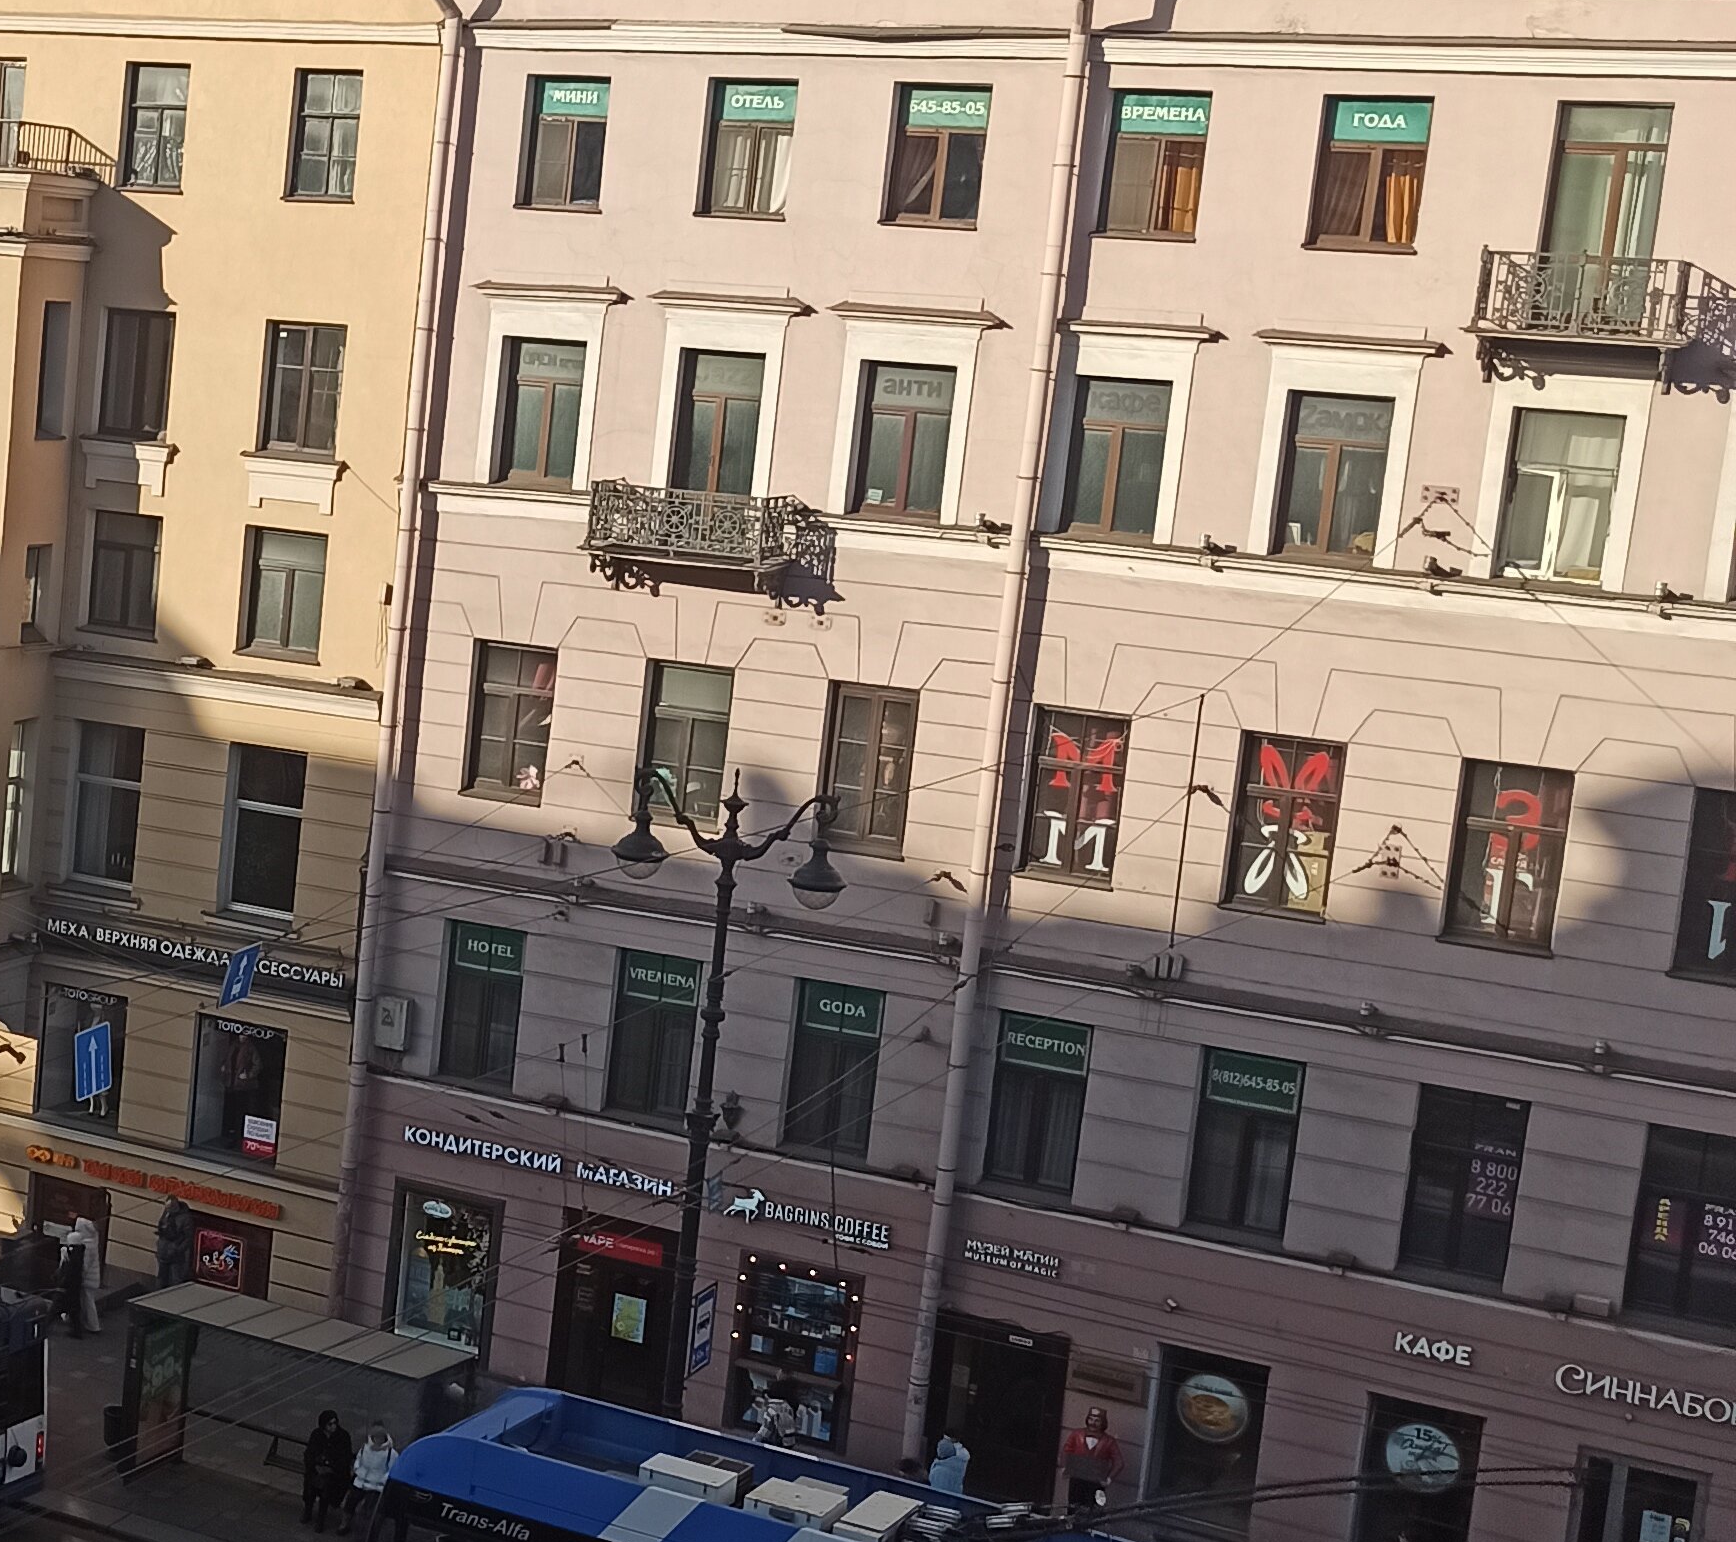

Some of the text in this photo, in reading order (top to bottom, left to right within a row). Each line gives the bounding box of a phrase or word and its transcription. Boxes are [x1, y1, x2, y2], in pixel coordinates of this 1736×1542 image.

[553, 90, 599, 105] МИНИ
[731, 94, 784, 109] ОТЕЛЬ
[1121, 106, 1206, 122] ВРЕМЕНА
[1353, 113, 1407, 129] ГОДА
[96, 928, 157, 953] ВЕРХНЯЯ
[253, 959, 343, 989] СЕССУАРЫ
[467, 939, 515, 958] HOTEL
[629, 967, 696, 990] VREMENA
[819, 999, 867, 1019] GODA
[217, 1019, 276, 1040] TOTOGROUP
[1008, 1031, 1087, 1057] RECEPTION
[404, 1125, 673, 1197] КОНДИТЕРСКИЙ МАГАЗИН
[1471, 1158, 1518, 1181] 8 800
[1476, 1177, 1508, 1197] 222
[1466, 1192, 1512, 1216] 77 06
[765, 1201, 890, 1242] BAGGINS COFFEE
[1704, 1214, 1713, 1226] 8
[1708, 1229, 1736, 1245] 746
[966, 1239, 1059, 1267] МУЗЕЙ МАГИИ
[1698, 1241, 1718, 1256] 06
[964, 1250, 1058, 1279] MUSEUM OF MAGIC
[1395, 1331, 1472, 1366] КАФЕ
[440, 1502, 531, 1541] Trans-Alfa
